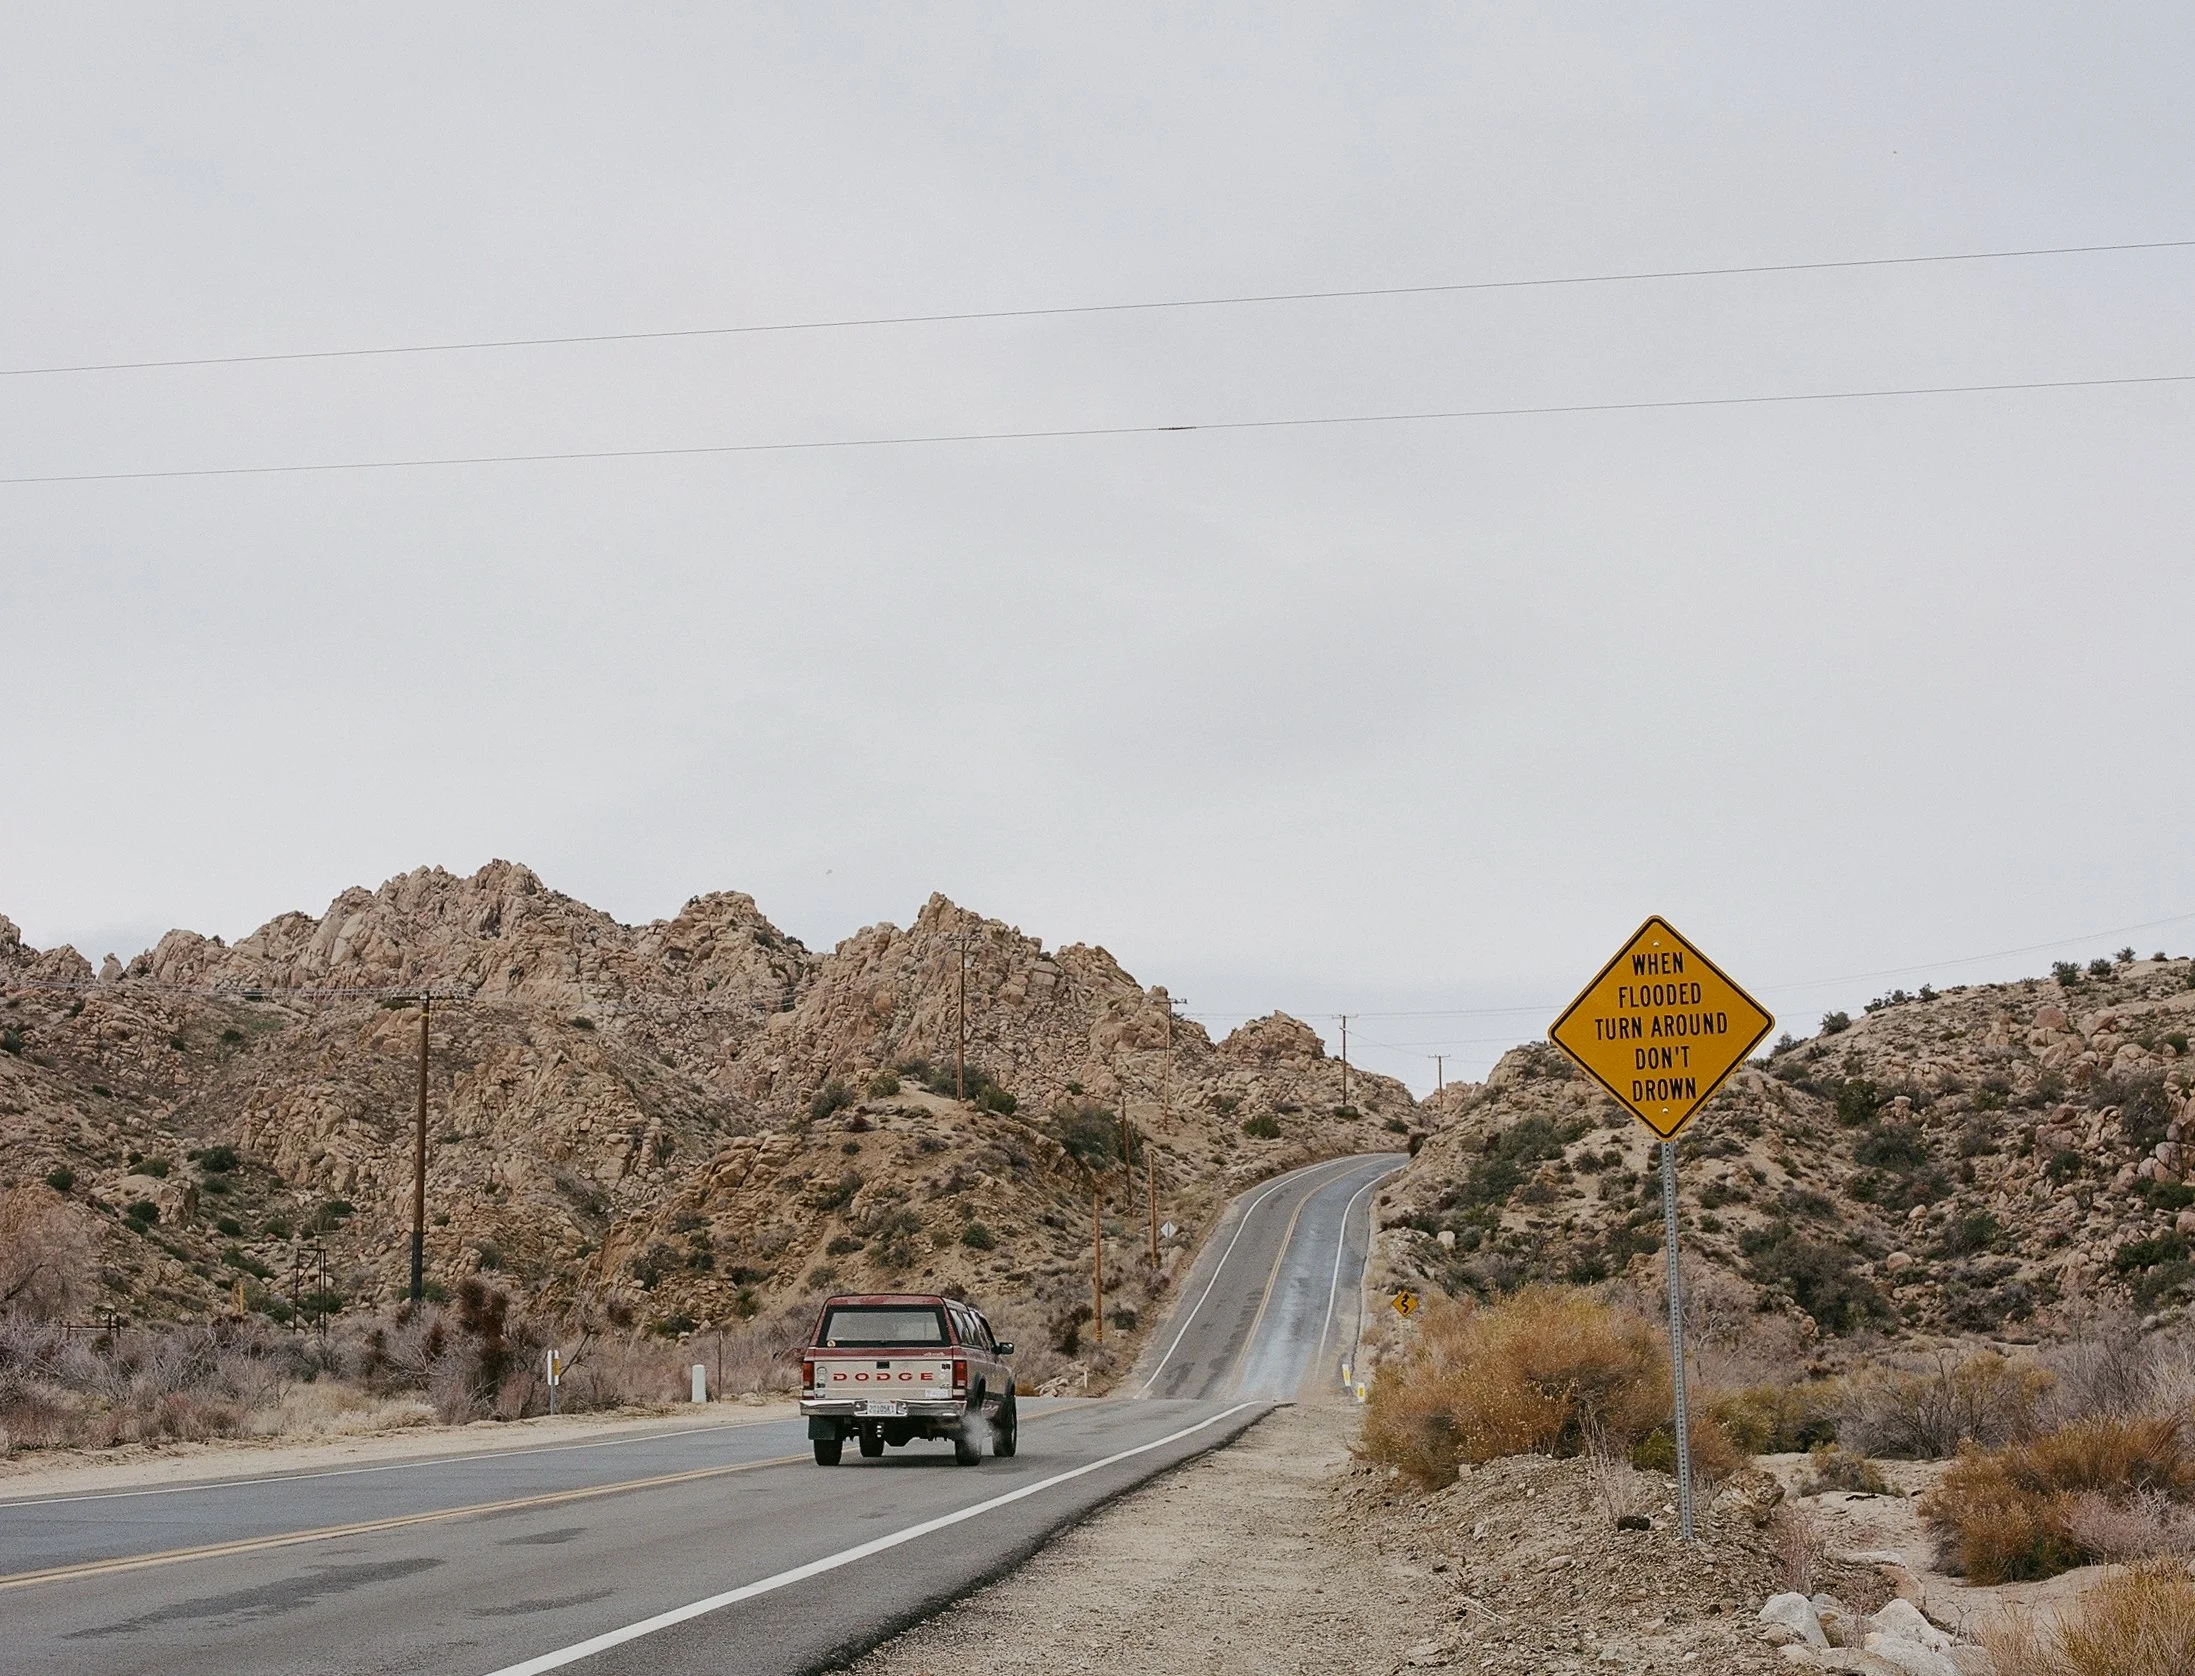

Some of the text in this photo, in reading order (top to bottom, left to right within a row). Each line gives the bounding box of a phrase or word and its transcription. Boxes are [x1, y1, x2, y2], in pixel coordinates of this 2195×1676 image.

[1632, 952, 1683, 975] WHEN
[1619, 983, 1701, 1008] FLOODED
[1595, 1013, 1727, 1040] TURN AROUND
[1636, 1046, 1689, 1070] DON'T
[1633, 1078, 1697, 1102] DROWN
[833, 1372, 934, 1381] DODGE
